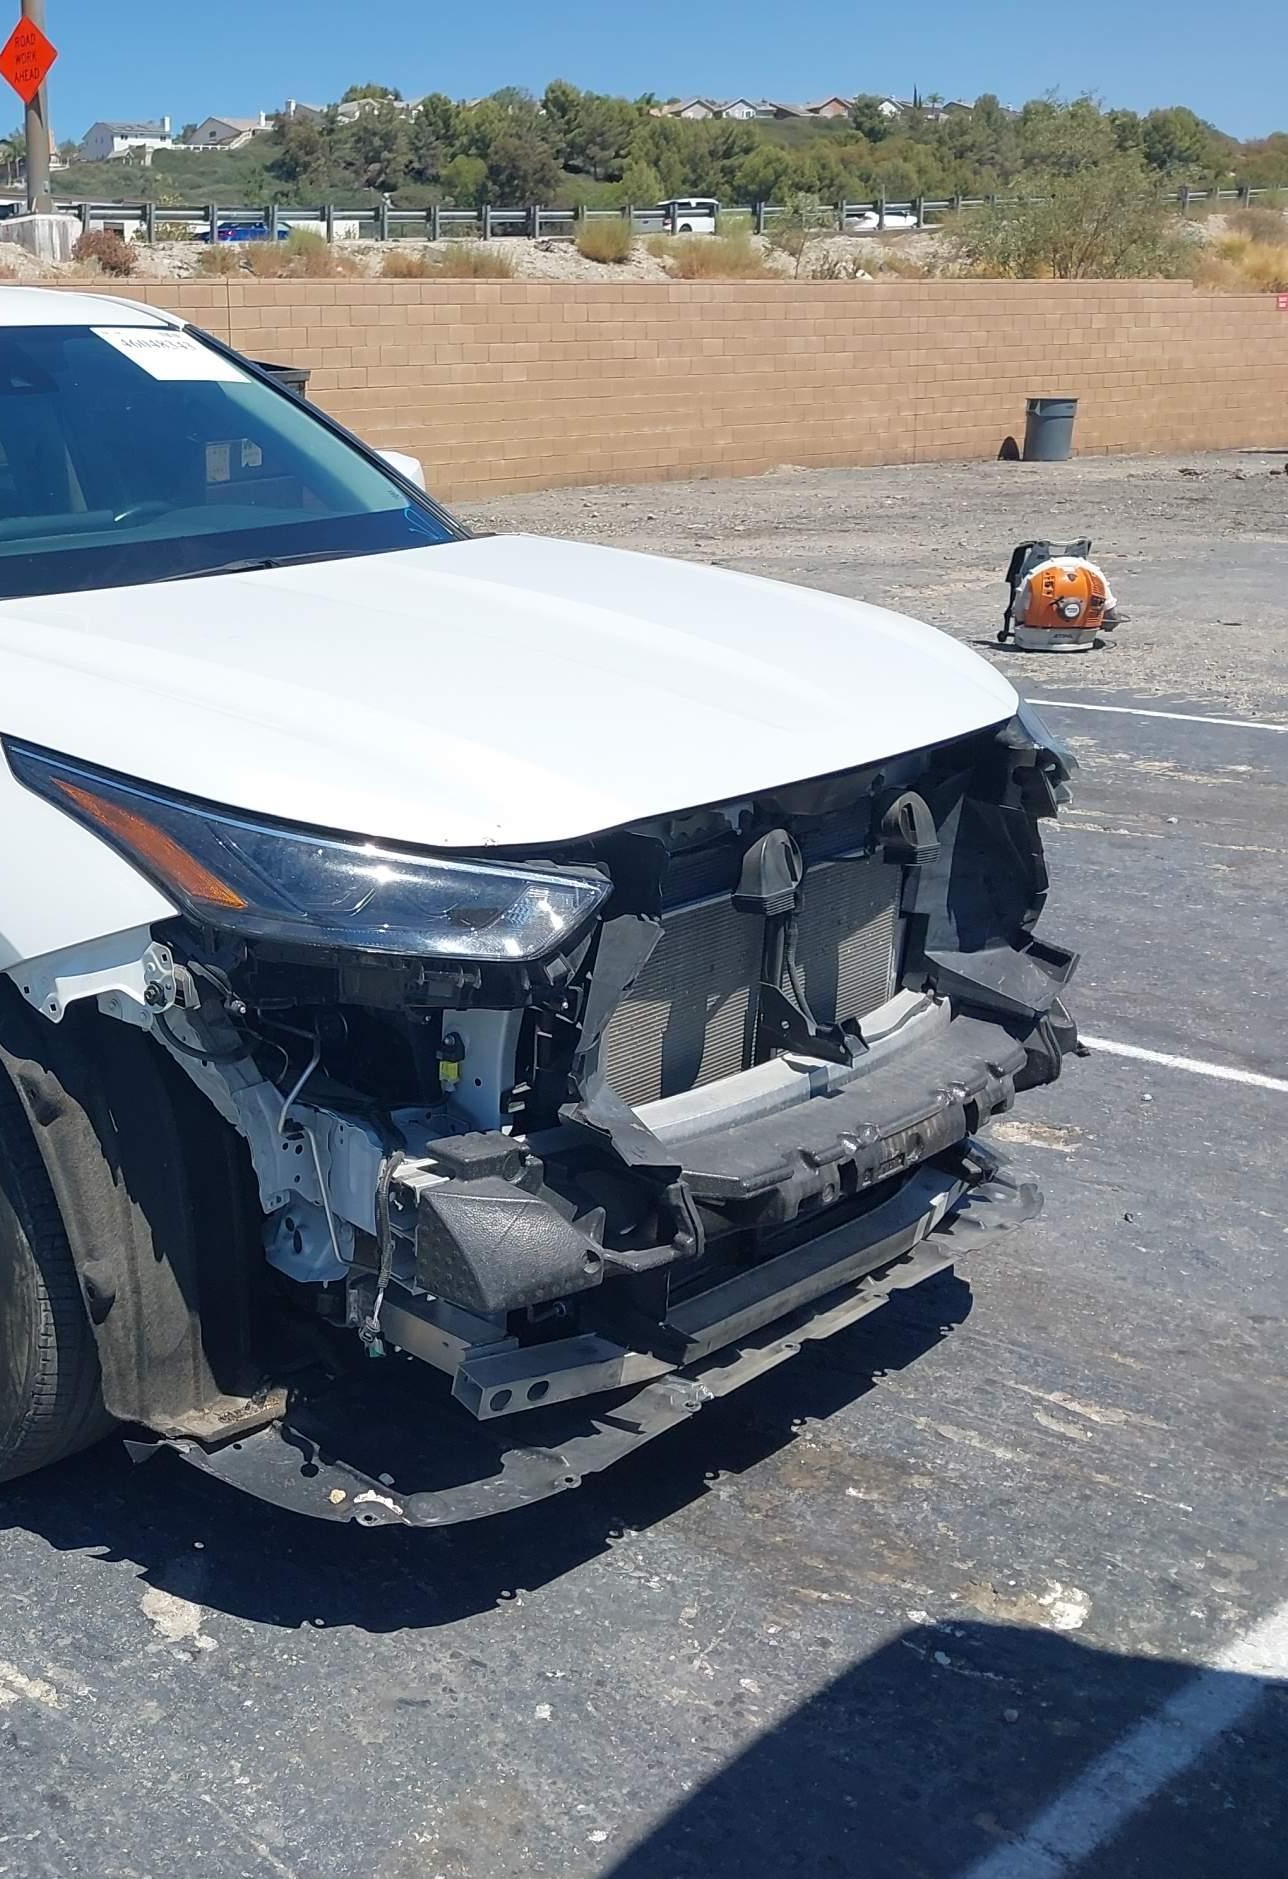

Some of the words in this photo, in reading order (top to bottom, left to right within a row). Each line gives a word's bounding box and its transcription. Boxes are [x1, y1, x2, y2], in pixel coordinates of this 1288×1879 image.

[15, 33, 36, 48] ROAD
[15, 50, 38, 65] WORK
[14, 67, 40, 83] AHEAD
